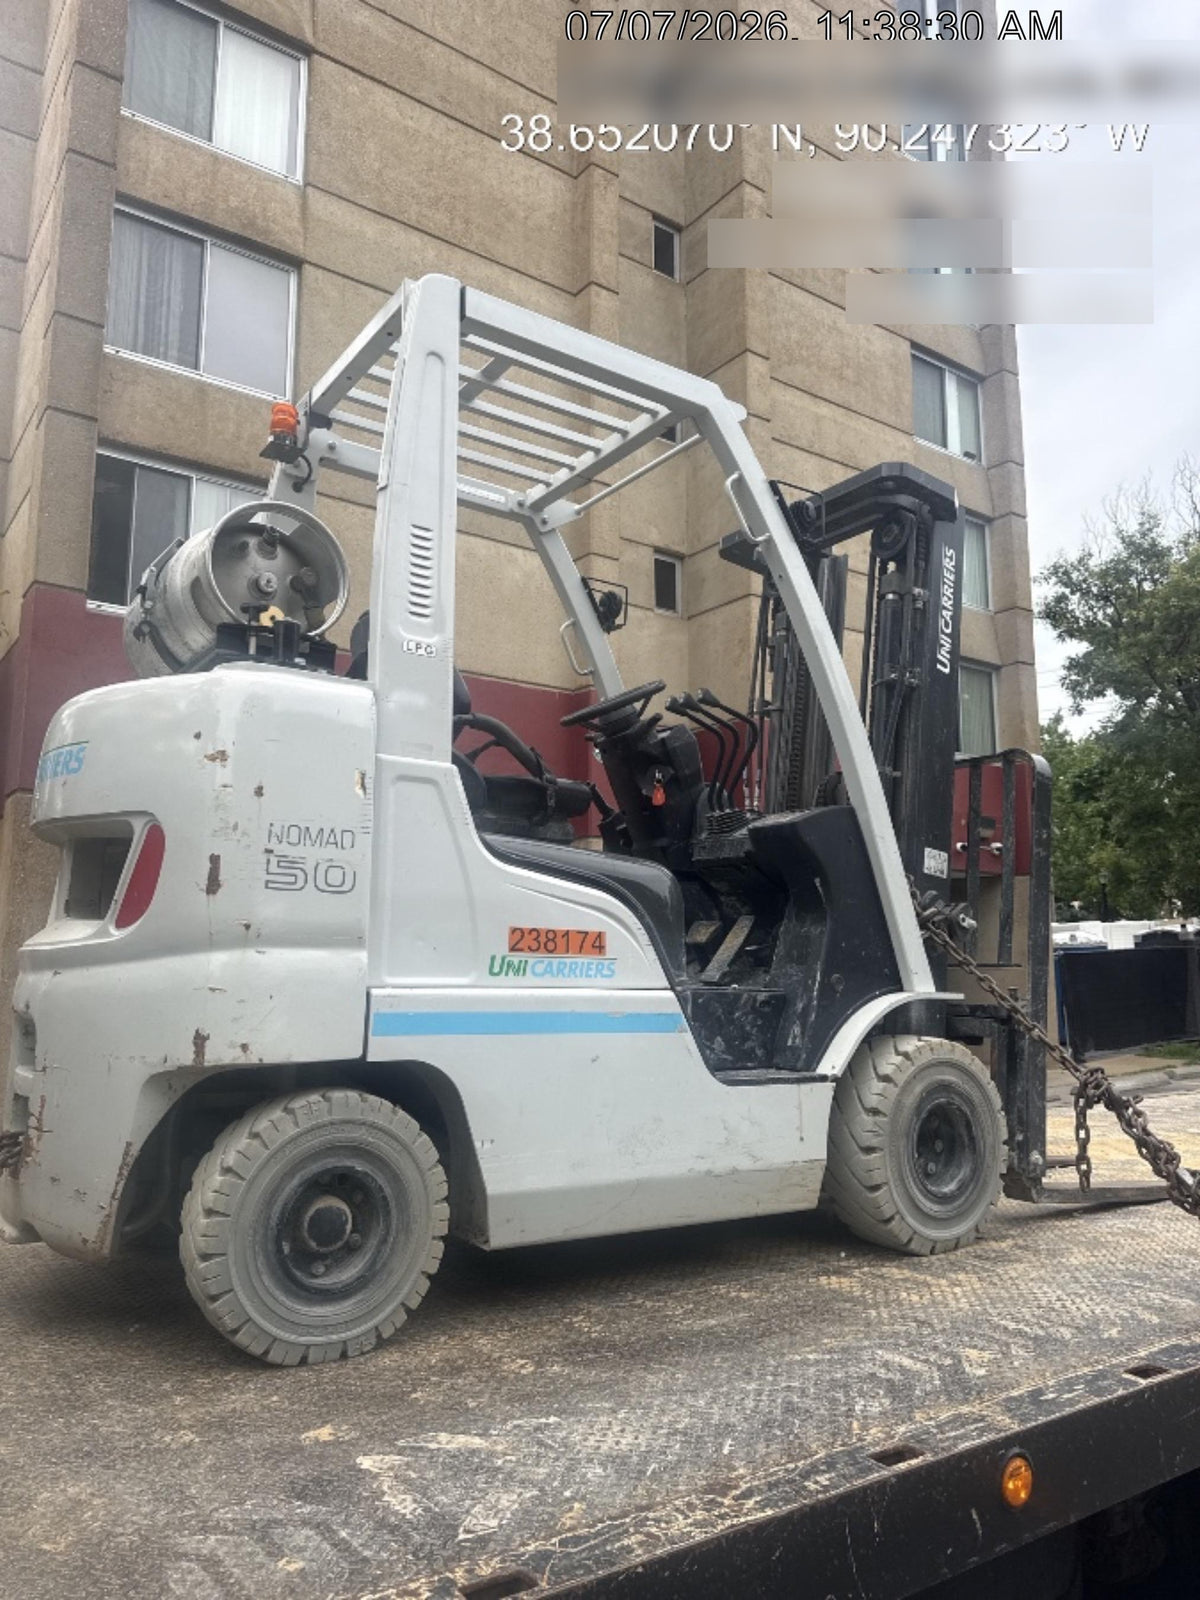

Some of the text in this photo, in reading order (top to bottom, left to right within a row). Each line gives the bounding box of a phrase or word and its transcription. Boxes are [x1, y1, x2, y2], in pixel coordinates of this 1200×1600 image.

[266, 822, 355, 850] NOMAD
[264, 853, 356, 894] 50
[510, 927, 605, 954] 238174
